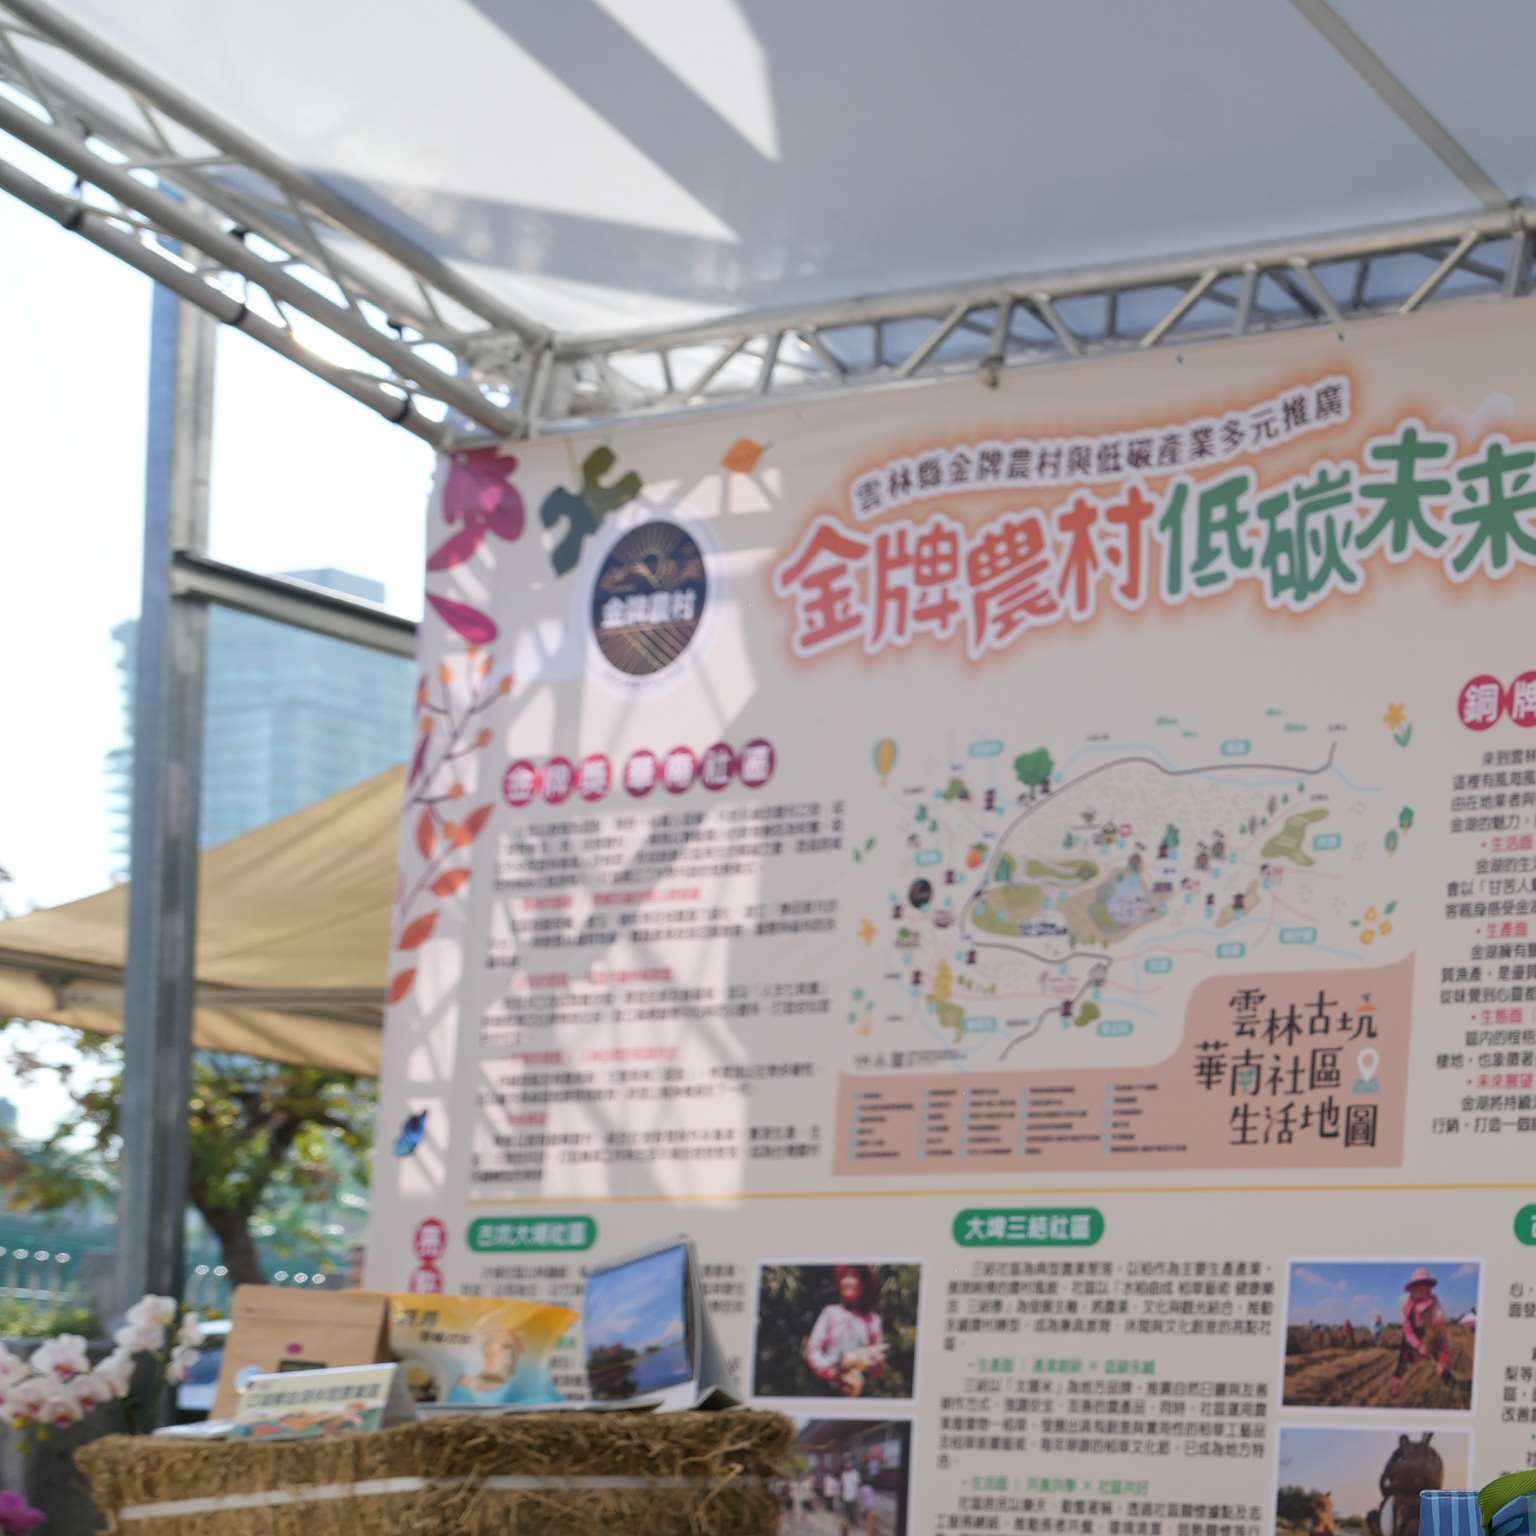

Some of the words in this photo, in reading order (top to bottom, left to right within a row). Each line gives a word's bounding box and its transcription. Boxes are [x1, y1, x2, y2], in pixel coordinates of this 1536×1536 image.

[1229, 988, 1378, 1047] 雲林古坑
[1195, 1041, 1341, 1096] 華南社區
[1229, 1096, 1378, 1148] 生活地圖
